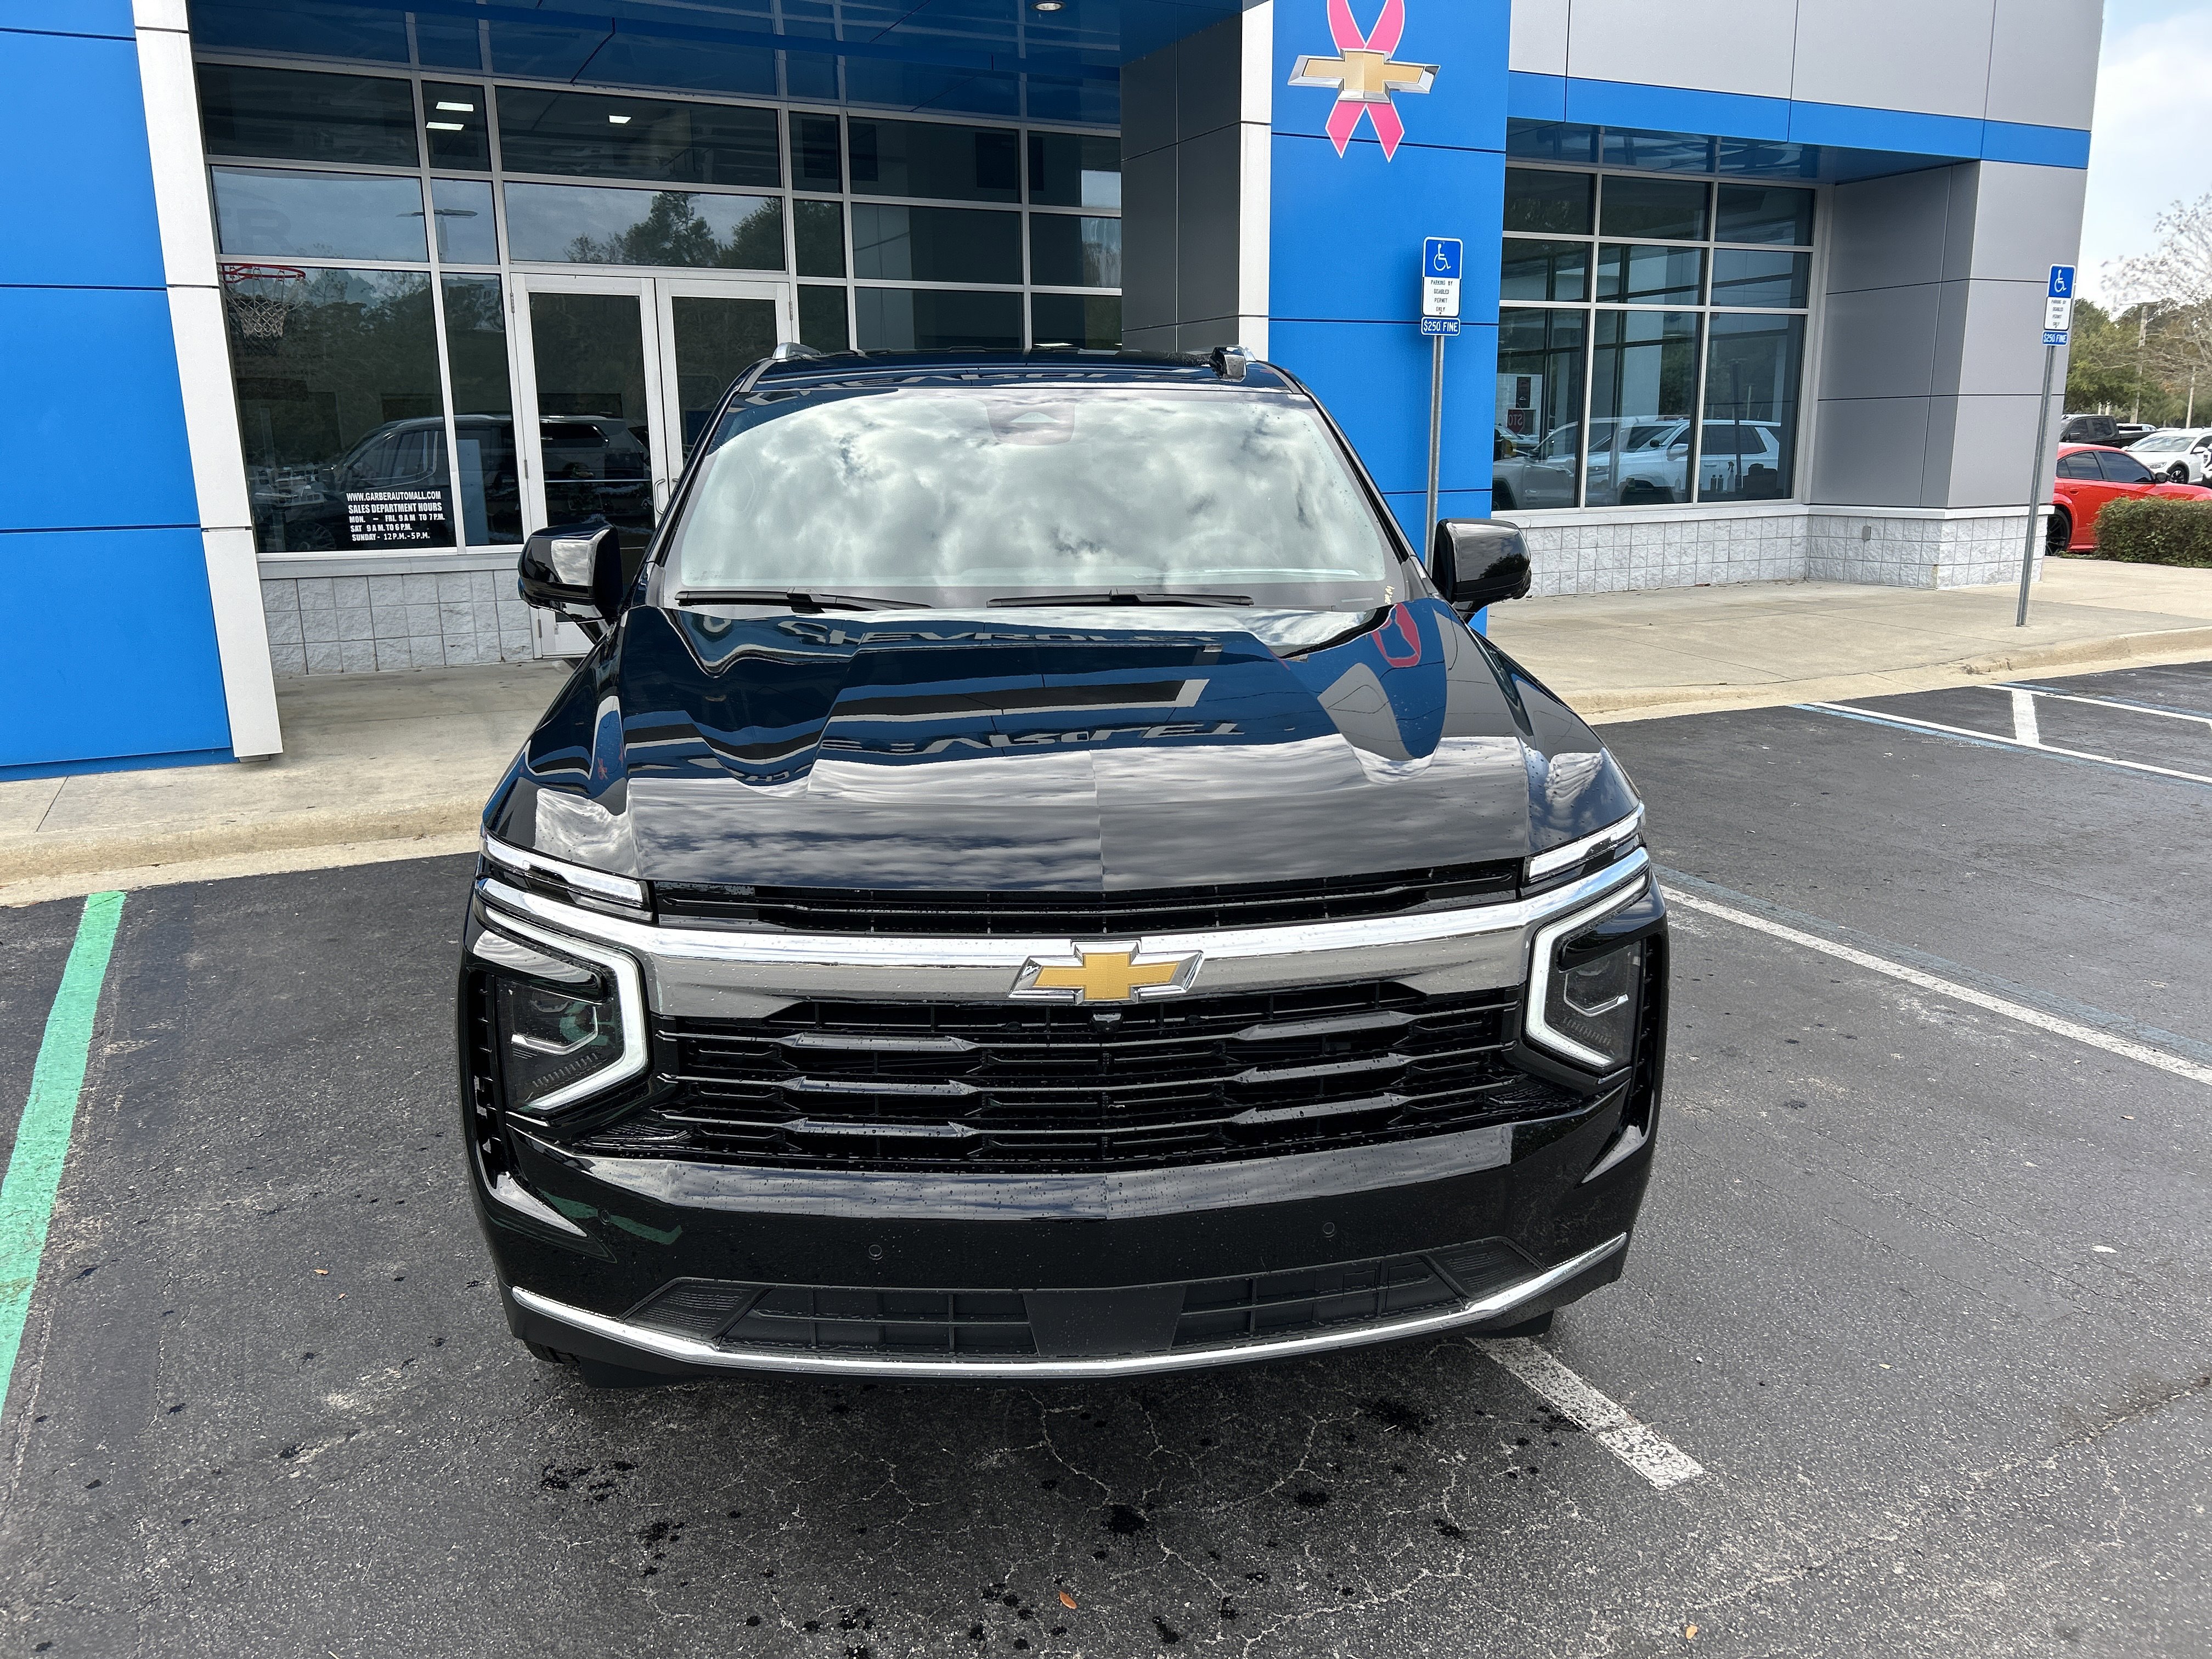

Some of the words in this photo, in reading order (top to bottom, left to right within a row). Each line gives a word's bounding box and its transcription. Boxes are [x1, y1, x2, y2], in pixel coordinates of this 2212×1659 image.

[1423, 319, 1441, 332] $250
[1442, 321, 1458, 332] FINE
[2056, 334, 2067, 343] FINE
[346, 490, 441, 501] WWW.GARBERAUTOMALL.COM
[348, 504, 370, 514] SALES
[371, 503, 417, 514] DEPARTMENT
[417, 502, 442, 512] HOURS
[349, 515, 366, 523] MON.
[350, 524, 362, 533] SAT
